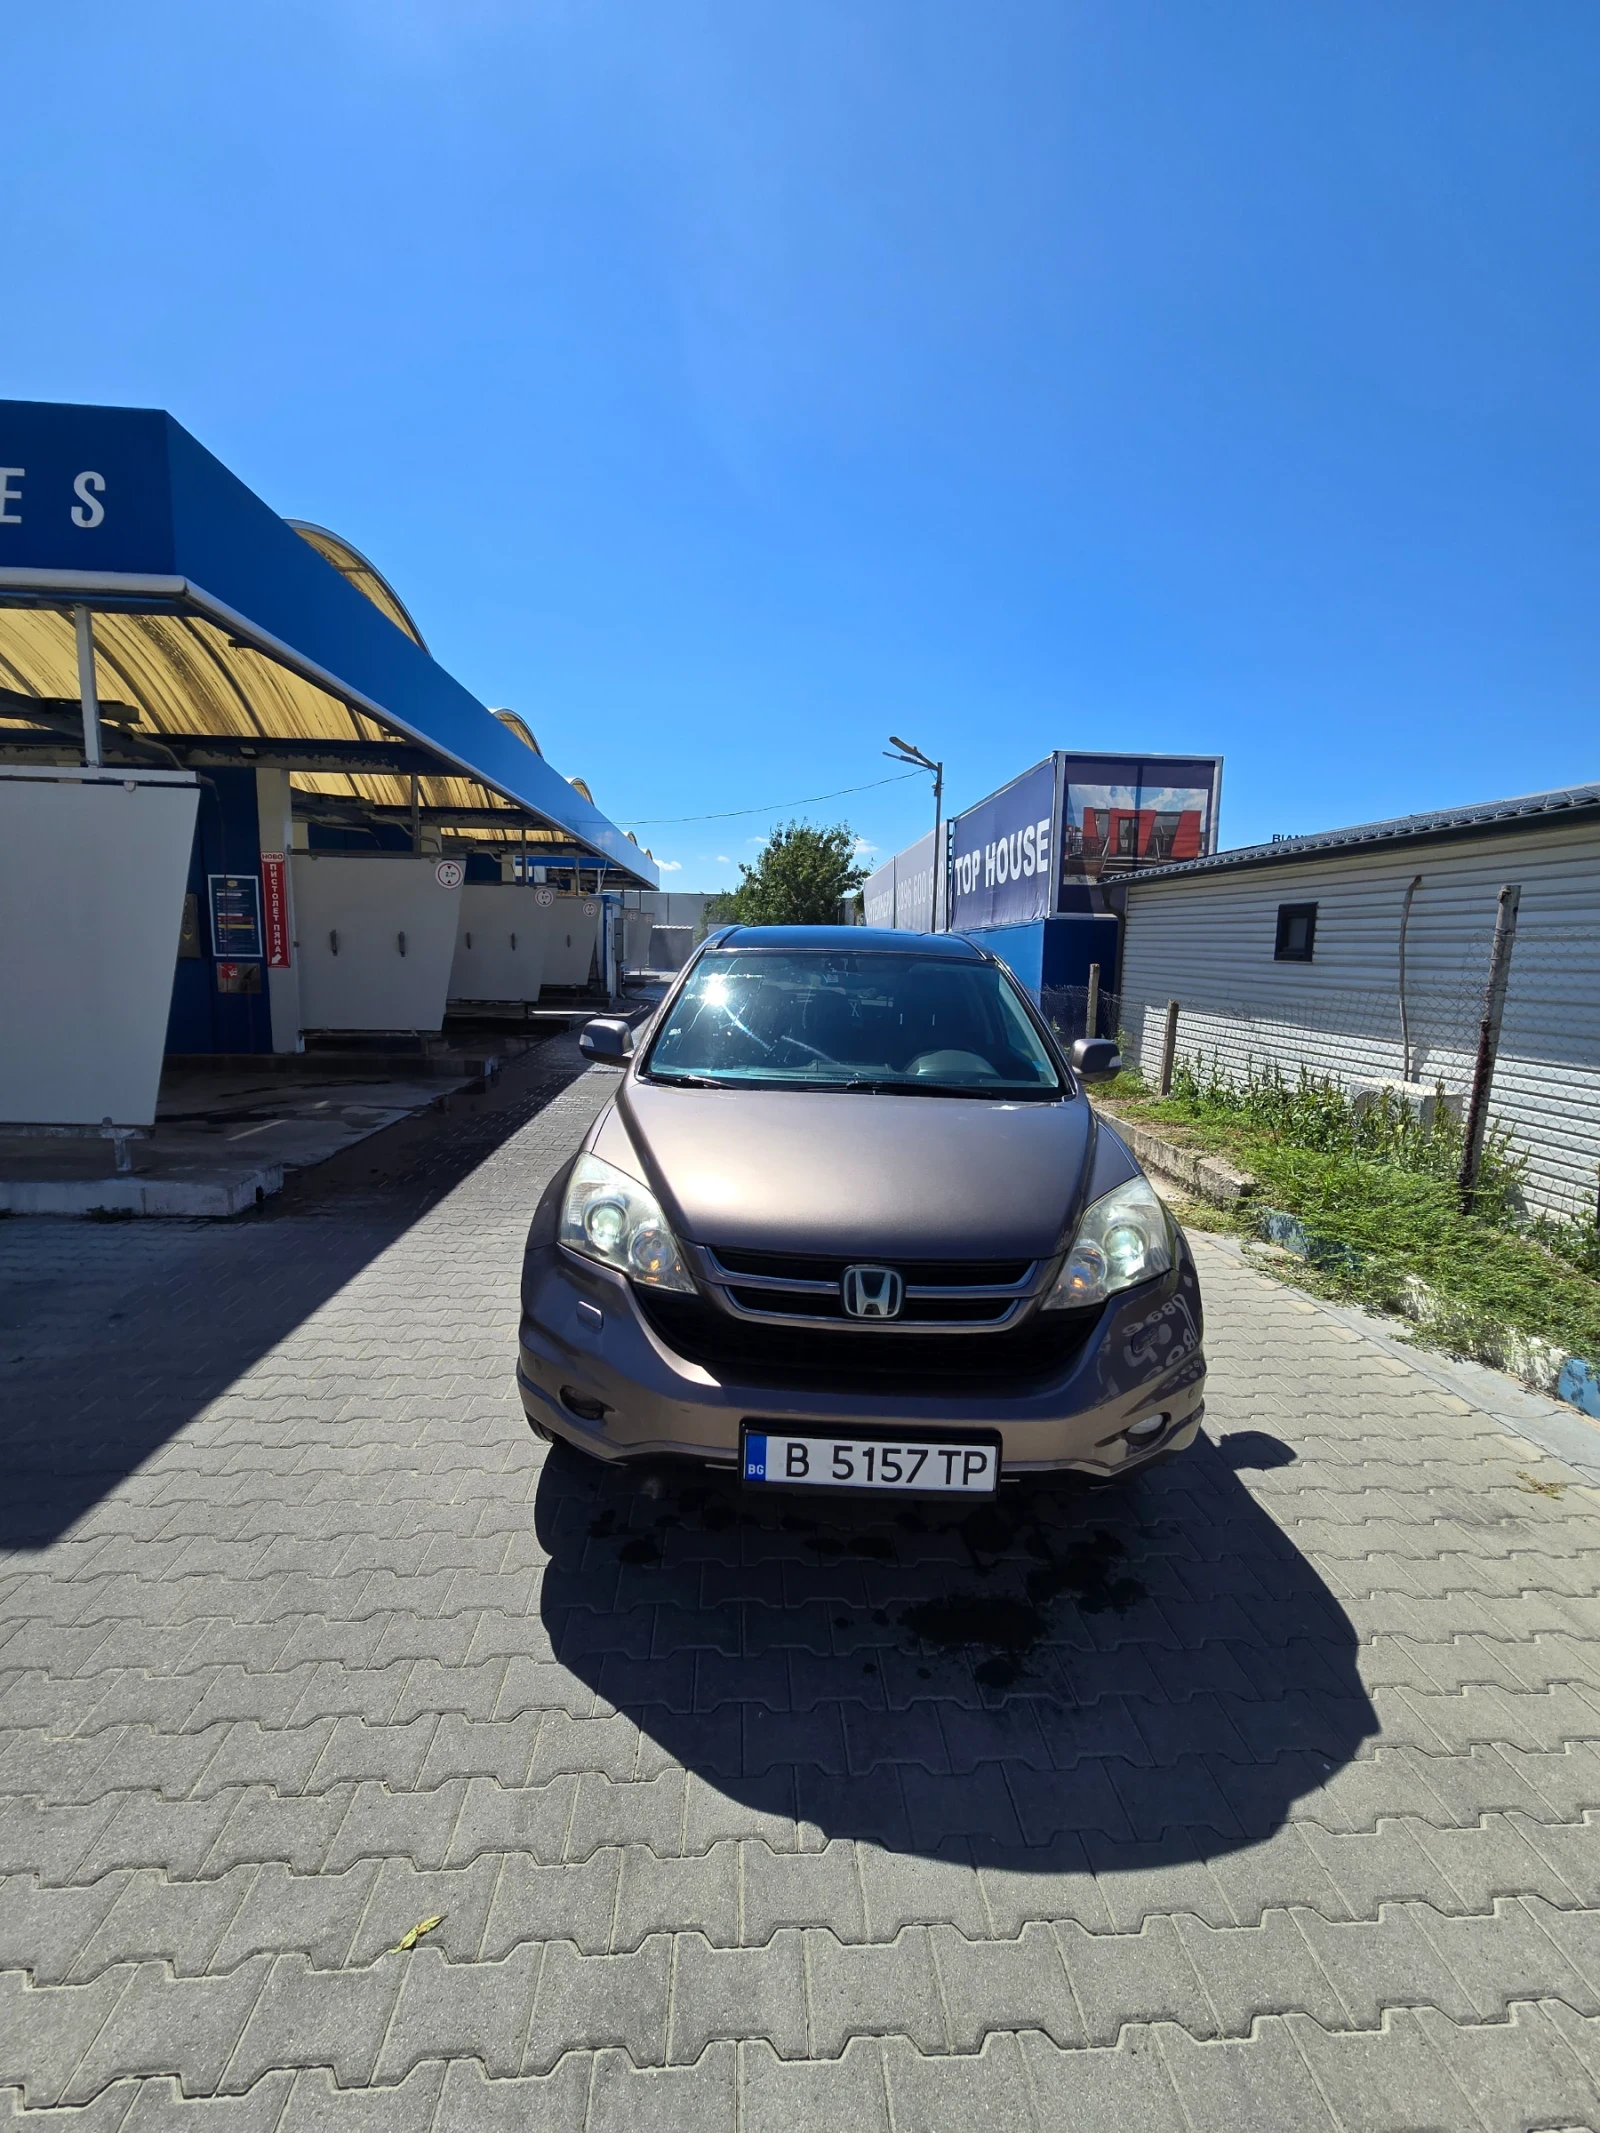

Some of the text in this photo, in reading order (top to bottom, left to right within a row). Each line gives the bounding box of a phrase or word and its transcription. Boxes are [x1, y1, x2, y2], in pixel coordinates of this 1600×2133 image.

[261, 853, 284, 861] НОВО
[954, 818, 1050, 896] TOP HOUSE
[269, 863, 282, 953] ПИСТОЛЕТ ПЯНА
[747, 1464, 765, 1476] BG
[786, 1443, 988, 1486] B 5157 TP
